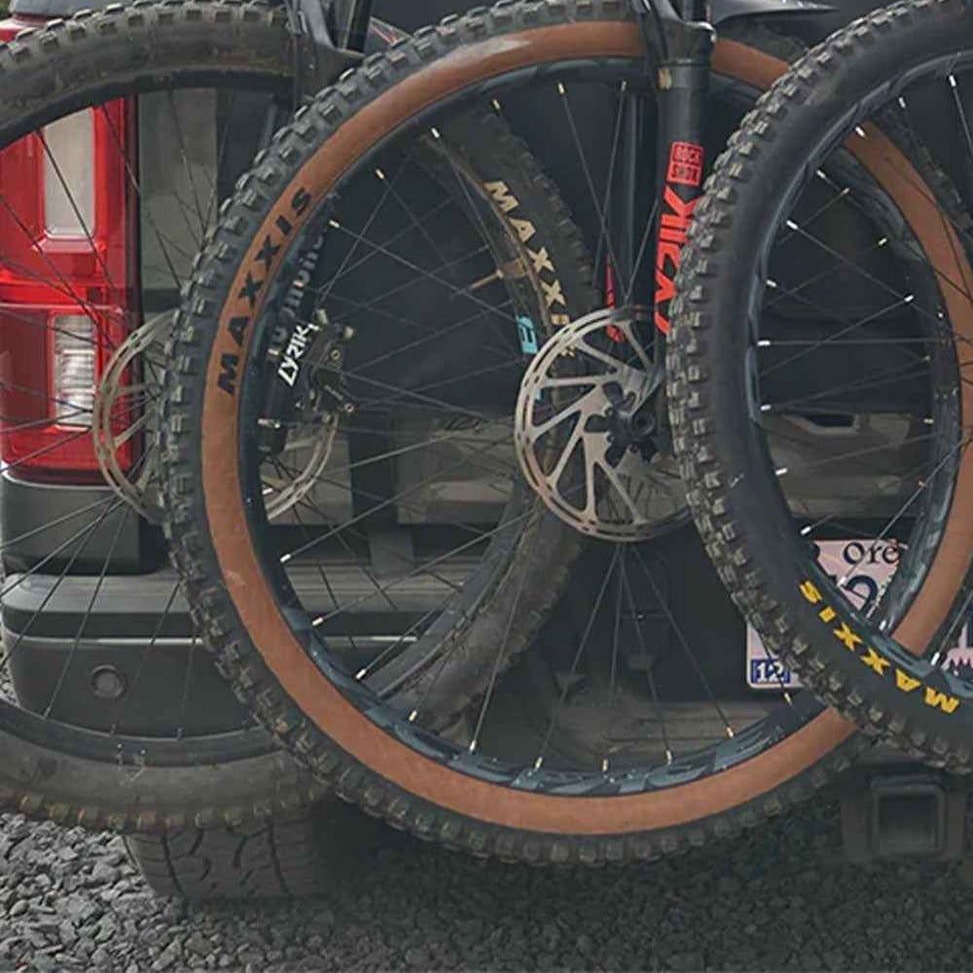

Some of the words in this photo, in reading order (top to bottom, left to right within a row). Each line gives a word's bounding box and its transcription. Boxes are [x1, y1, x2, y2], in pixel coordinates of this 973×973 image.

[217, 186, 313, 396] MAXXIS
[484, 180, 575, 356] MAXXI
[843, 542, 901, 565] Ore
[800, 581, 960, 713] MAXXIS
